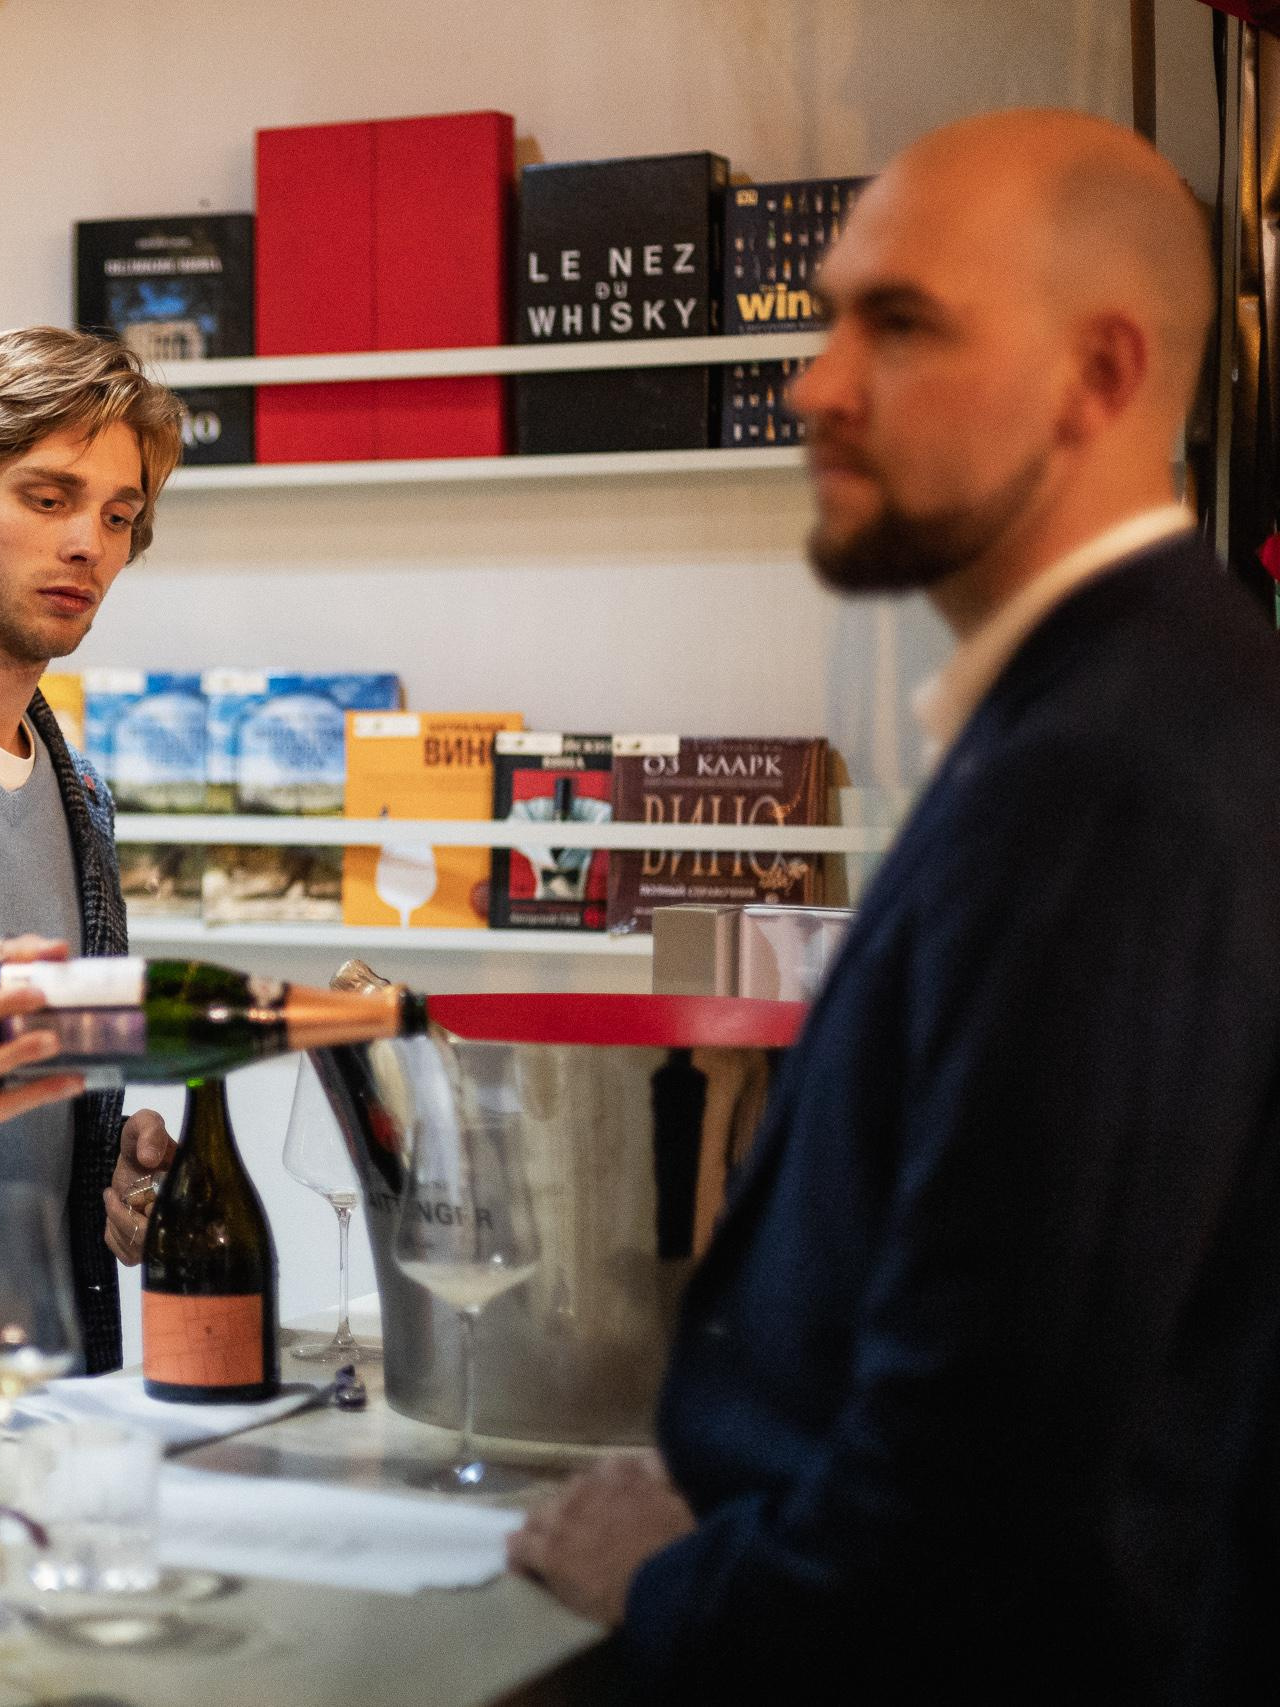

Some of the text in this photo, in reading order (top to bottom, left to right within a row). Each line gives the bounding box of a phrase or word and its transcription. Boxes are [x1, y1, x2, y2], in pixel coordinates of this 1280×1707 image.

[527, 242, 696, 284] LE NEZ
[594, 280, 628, 300] DU
[526, 297, 697, 338] WHISKY
[424, 736, 491, 768] ВИН
[696, 753, 784, 777] КЛАРК
